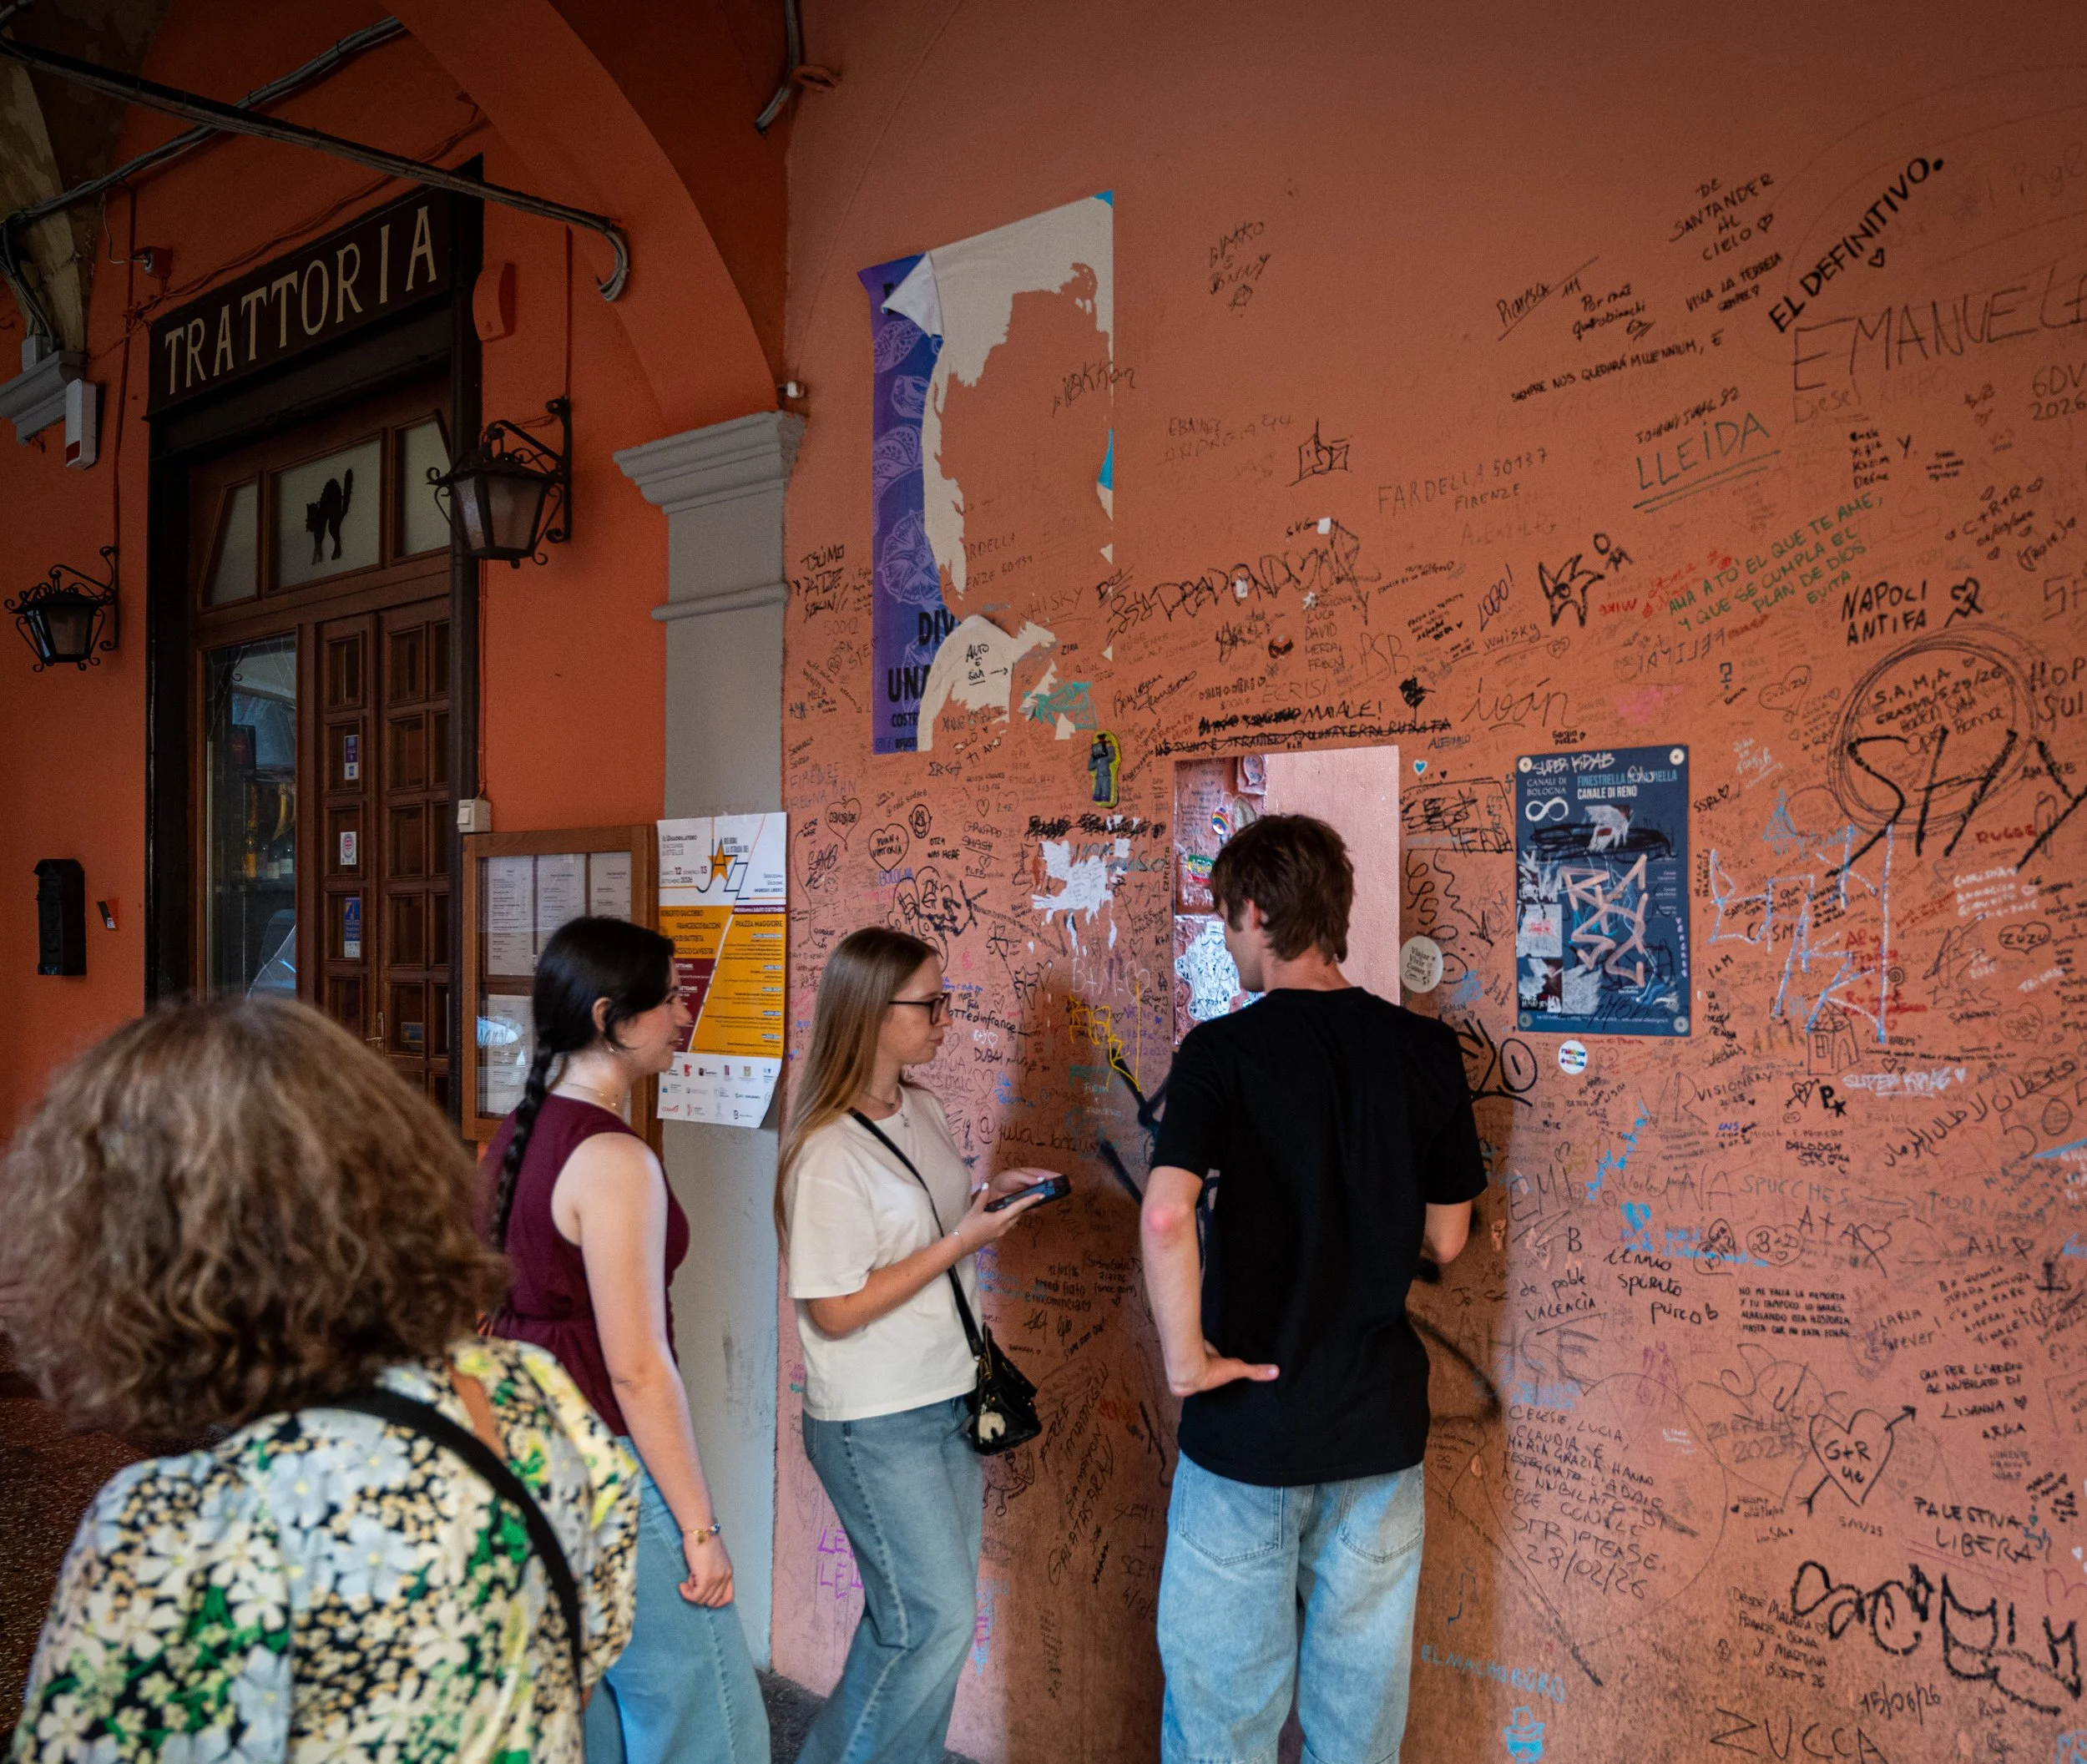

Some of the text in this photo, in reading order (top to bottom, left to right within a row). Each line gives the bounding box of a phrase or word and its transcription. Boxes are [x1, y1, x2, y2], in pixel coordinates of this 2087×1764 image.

[1669, 174, 1774, 242] SANTANDER
[1702, 227, 1751, 260] CIELO
[1767, 158, 1943, 334] EL DEFINITIVO.
[165, 206, 437, 395] TRATTORIA
[1771, 529, 1806, 559] QUE
[1808, 514, 1833, 535] TE
[1696, 597, 1732, 624] QUE
[1761, 541, 1826, 589] CUMPLA
[1842, 579, 1927, 621] NAPOLI
[1847, 609, 1927, 647] ANTIFA
[1526, 776, 1567, 787] CANALI DI
[1526, 787, 1567, 796] BOLOGNA
[1577, 786, 1638, 800] CANALE DI RENO
[1944, 1364, 1966, 1376] PER
[2005, 1373, 2021, 1386] DI
[1516, 1425, 1579, 1452] CLAUDIA
